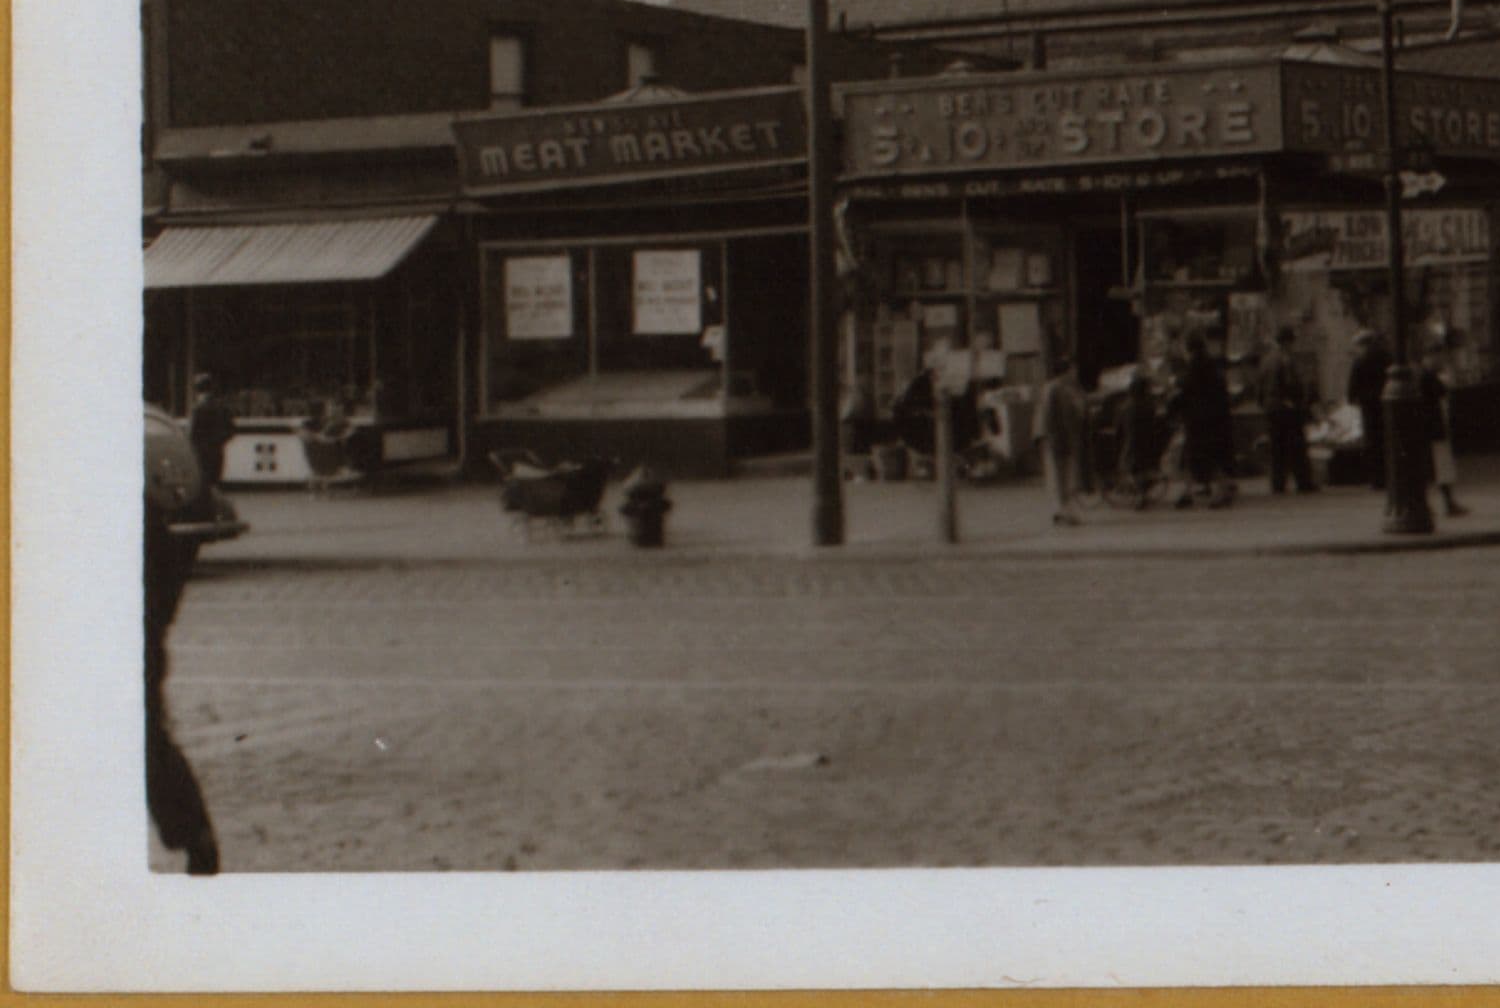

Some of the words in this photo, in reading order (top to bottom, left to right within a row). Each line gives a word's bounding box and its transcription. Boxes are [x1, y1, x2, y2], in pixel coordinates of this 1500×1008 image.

[1033, 87, 1083, 111] CUT
[1098, 78, 1172, 106] RATE
[479, 137, 590, 177] MEAT
[608, 120, 782, 165] MARKET
[1059, 102, 1256, 156] STORE
[965, 179, 1000, 196] CUT
[1018, 175, 1065, 194] RATE
